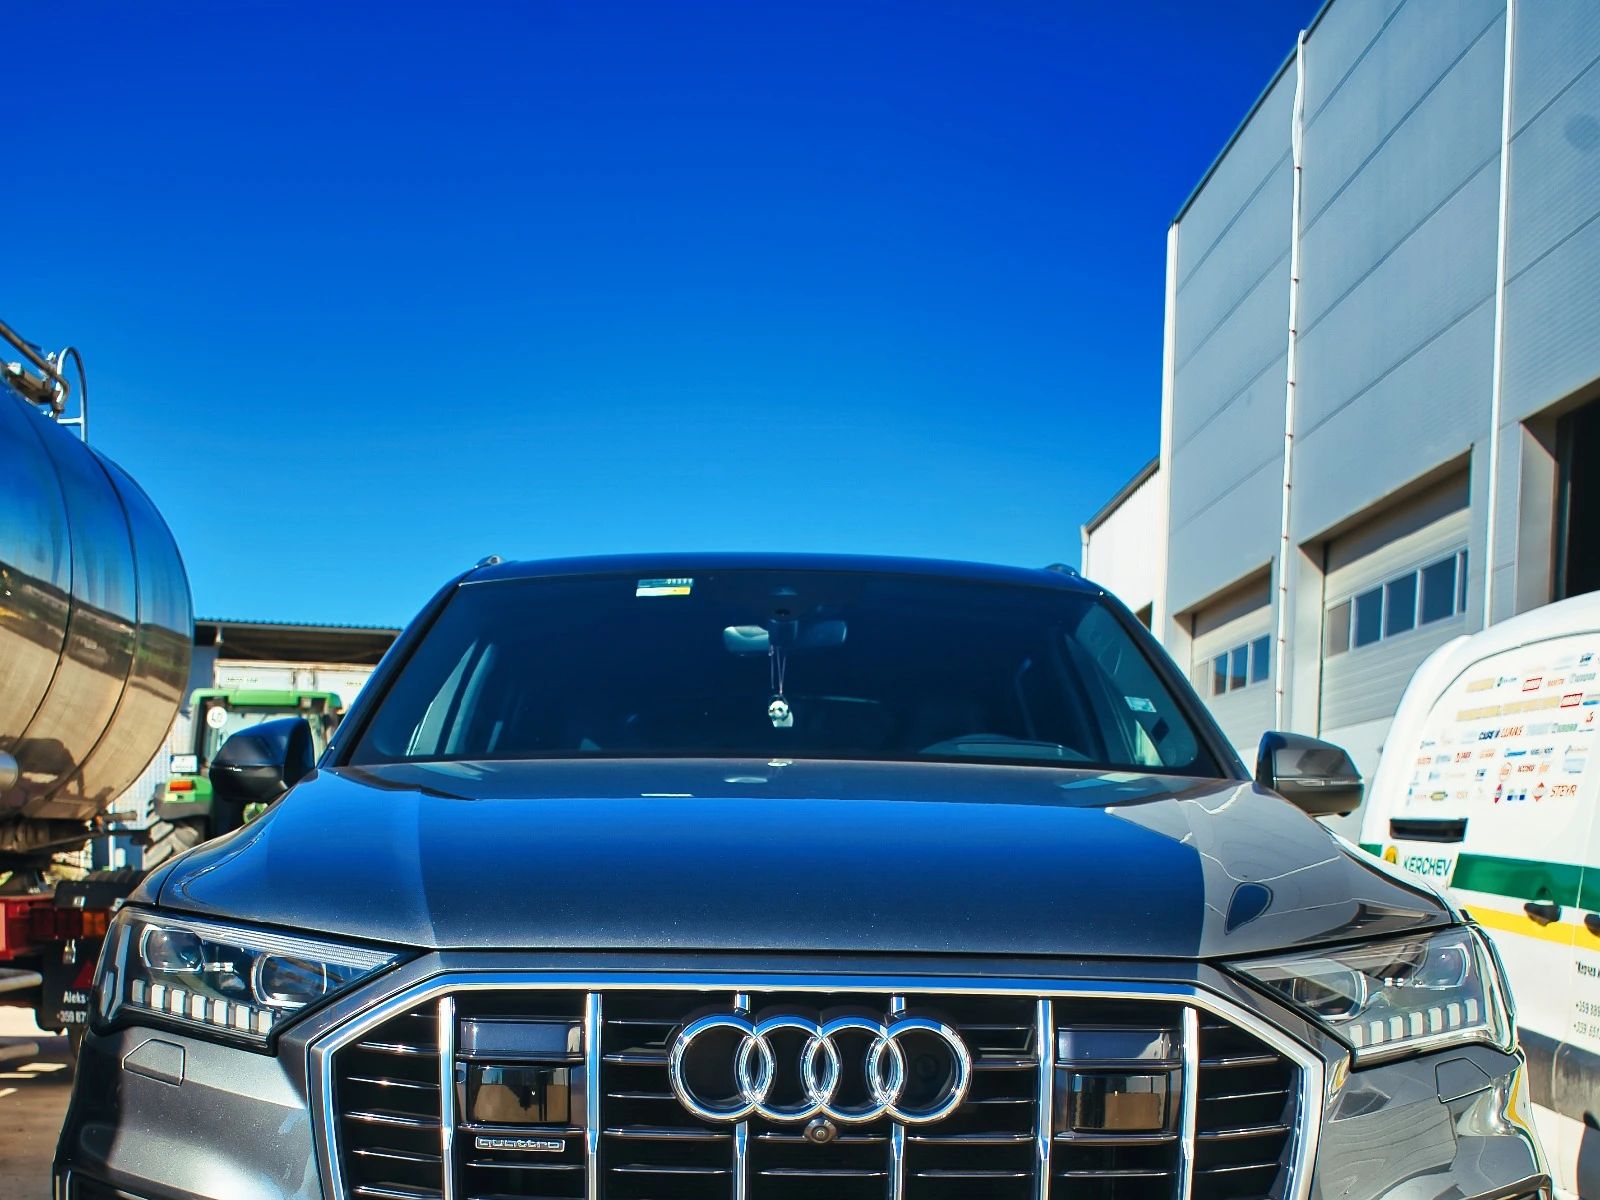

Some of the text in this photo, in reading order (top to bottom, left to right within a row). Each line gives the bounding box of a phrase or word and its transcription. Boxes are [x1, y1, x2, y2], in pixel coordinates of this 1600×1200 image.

[1550, 784, 1577, 798] STEYR
[1403, 856, 1452, 876] KERCHEV
[63, 990, 89, 1004] Aleks
[479, 1138, 561, 1149] quattro
